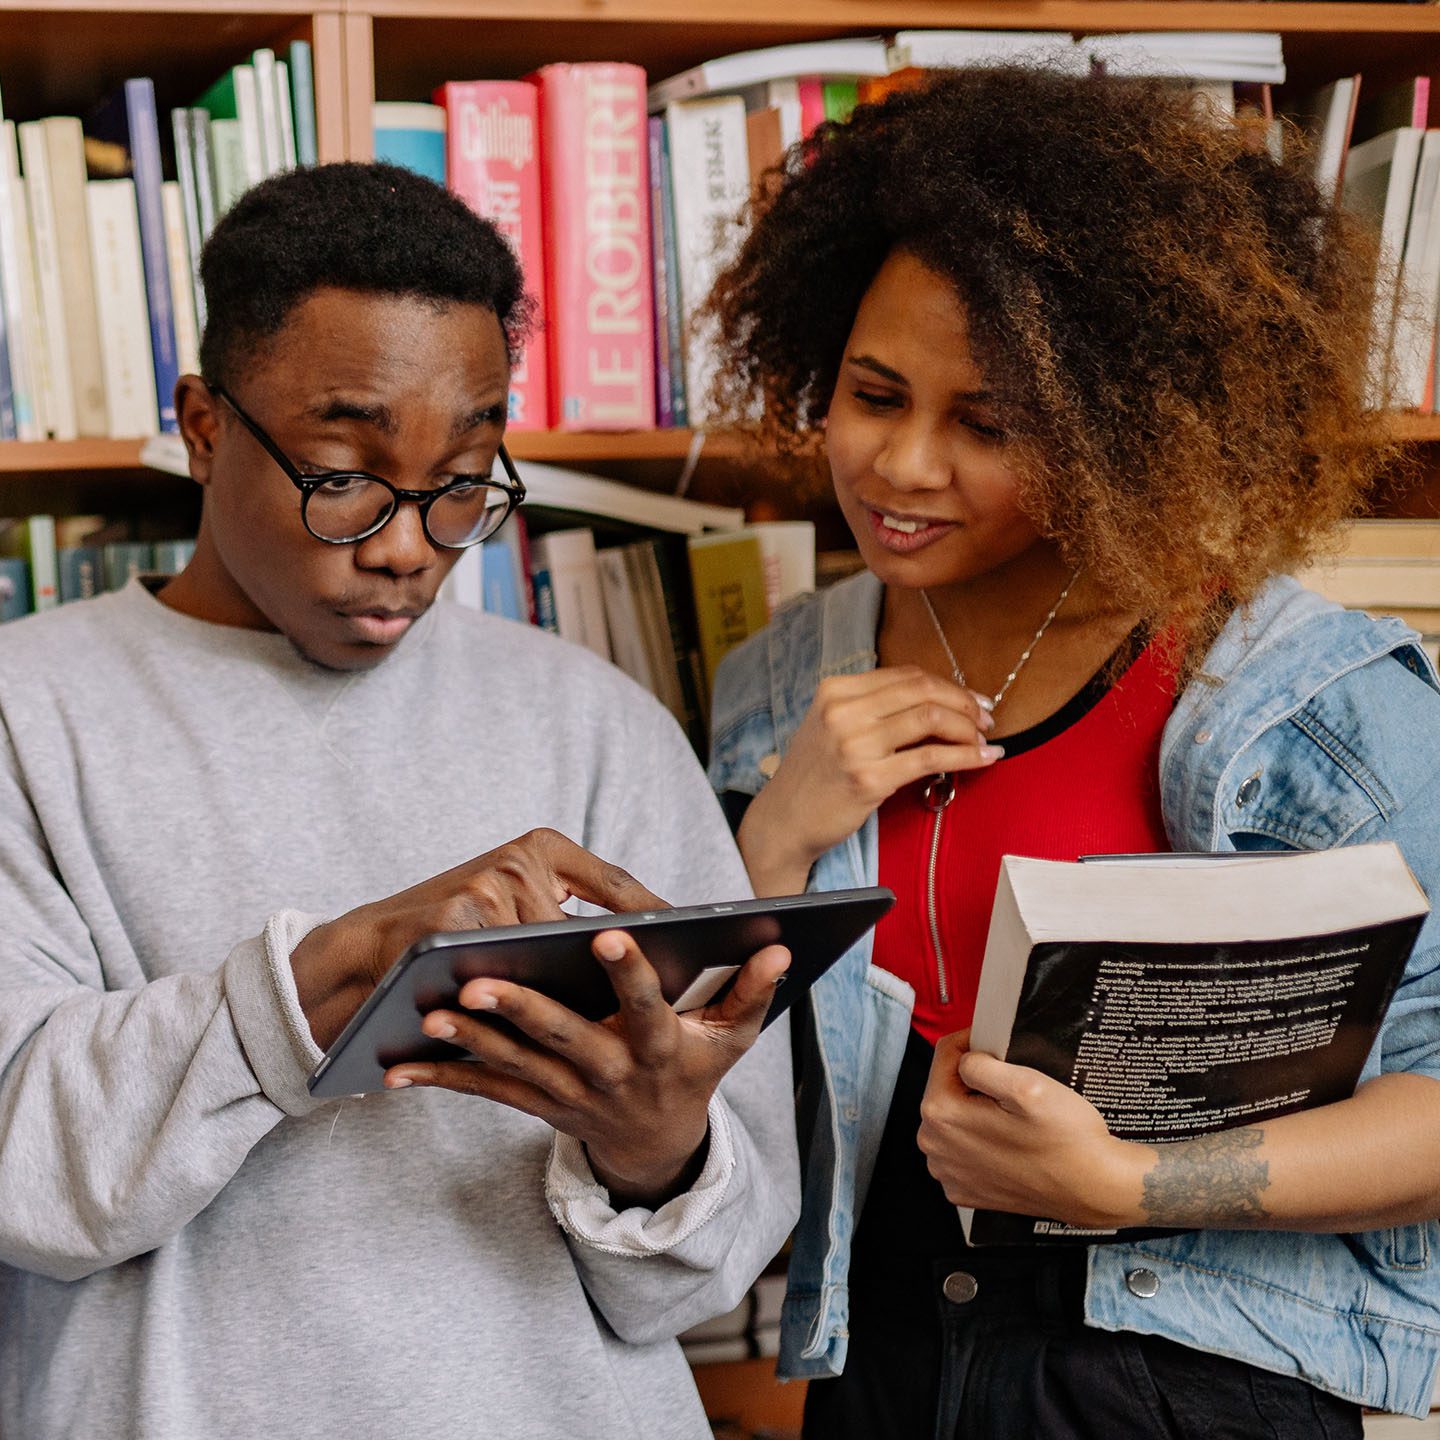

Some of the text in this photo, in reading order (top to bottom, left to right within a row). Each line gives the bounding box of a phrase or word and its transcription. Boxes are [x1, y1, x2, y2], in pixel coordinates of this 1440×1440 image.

[585, 77, 643, 421] LE ROBERT
[1100, 960, 1146, 970] Marketing
[1224, 960, 1261, 969] textbook
[1098, 968, 1145, 976] marketing.
[1096, 977, 1135, 986] Carefully
[1137, 979, 1183, 987] developed
[1130, 999, 1194, 1007] clearly-marked
[1205, 1011, 1235, 1019] student
[1098, 1024, 1136, 1032] practice.
[1082, 1032, 1126, 1041] Marketing
[1080, 1039, 1123, 1048] marketing
[1079, 1045, 1119, 1054] providing
[1122, 1047, 1184, 1055] comprehensive
[1156, 1054, 1206, 1062] applications
[1074, 1063, 1108, 1072] practice
[1087, 1071, 1125, 1079] precision
[1108, 1079, 1150, 1087] marketing
[1083, 1083, 1176, 1094] environmental analysis
[1082, 1089, 1167, 1100] conviction marketing
[1154, 1096, 1206, 1105] development
